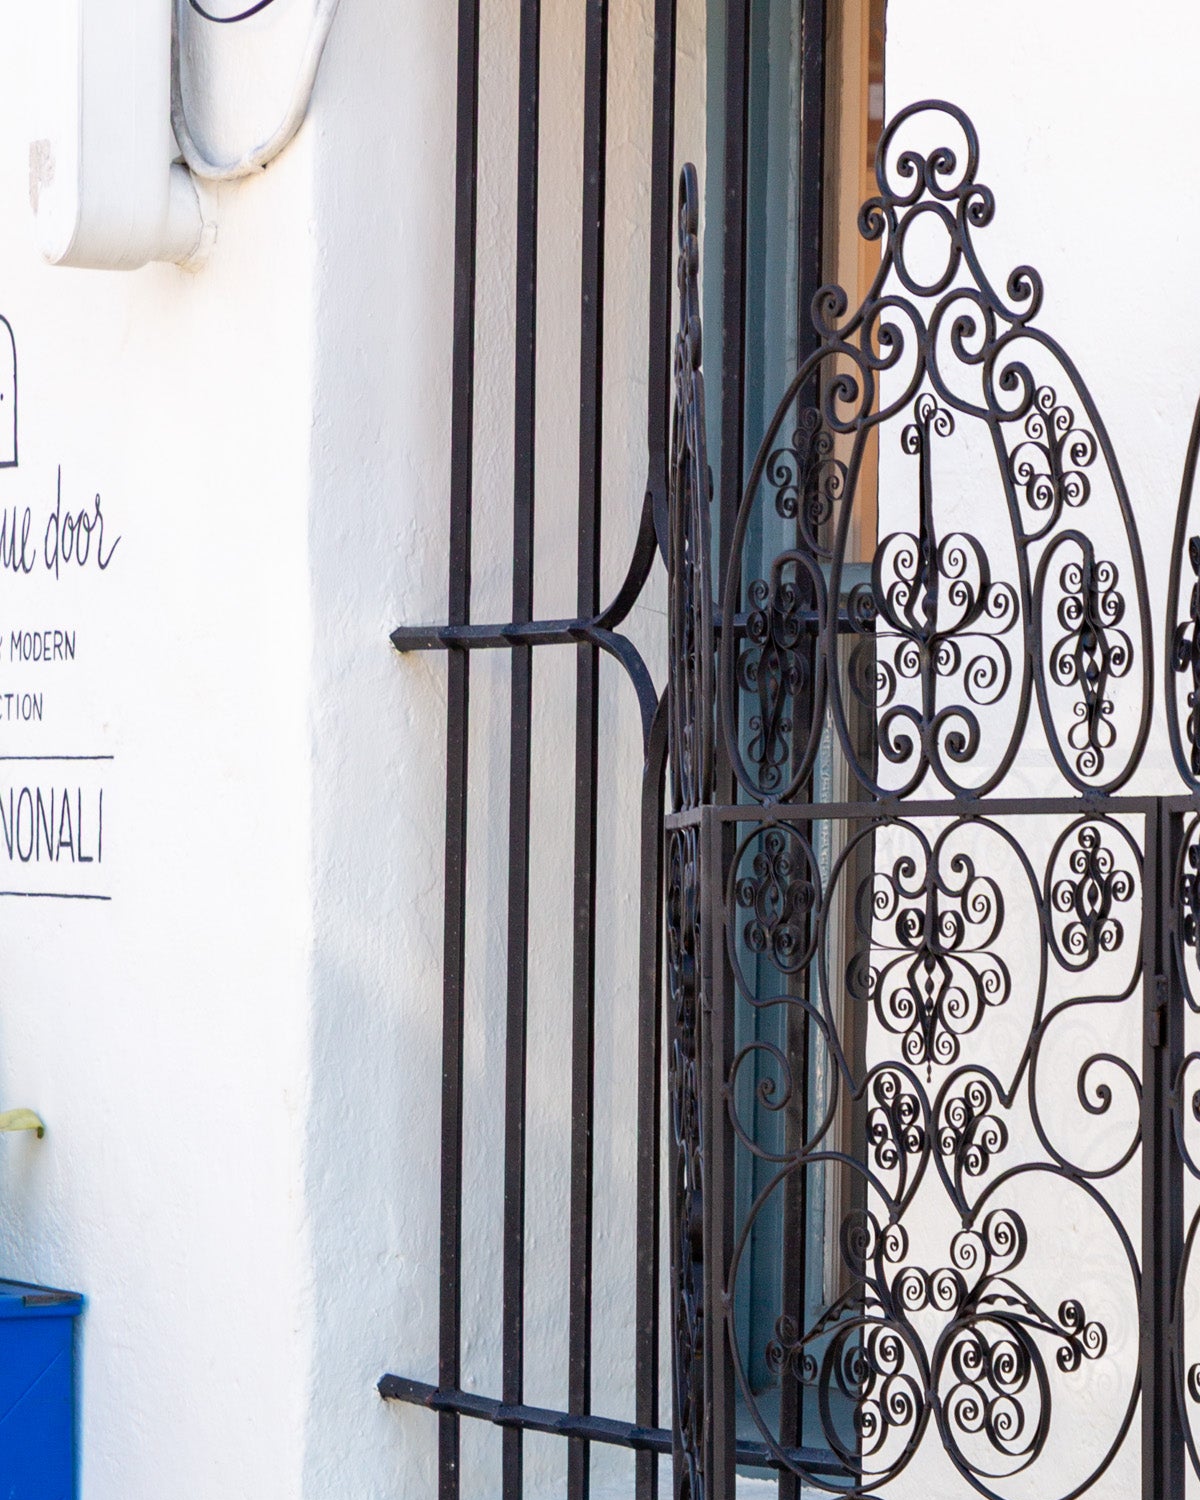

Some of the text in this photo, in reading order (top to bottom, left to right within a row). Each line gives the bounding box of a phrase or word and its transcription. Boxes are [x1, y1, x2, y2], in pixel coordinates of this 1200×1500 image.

[0, 463, 122, 581] ue door
[10, 629, 76, 662] MODERN
[0, 692, 43, 722] TION
